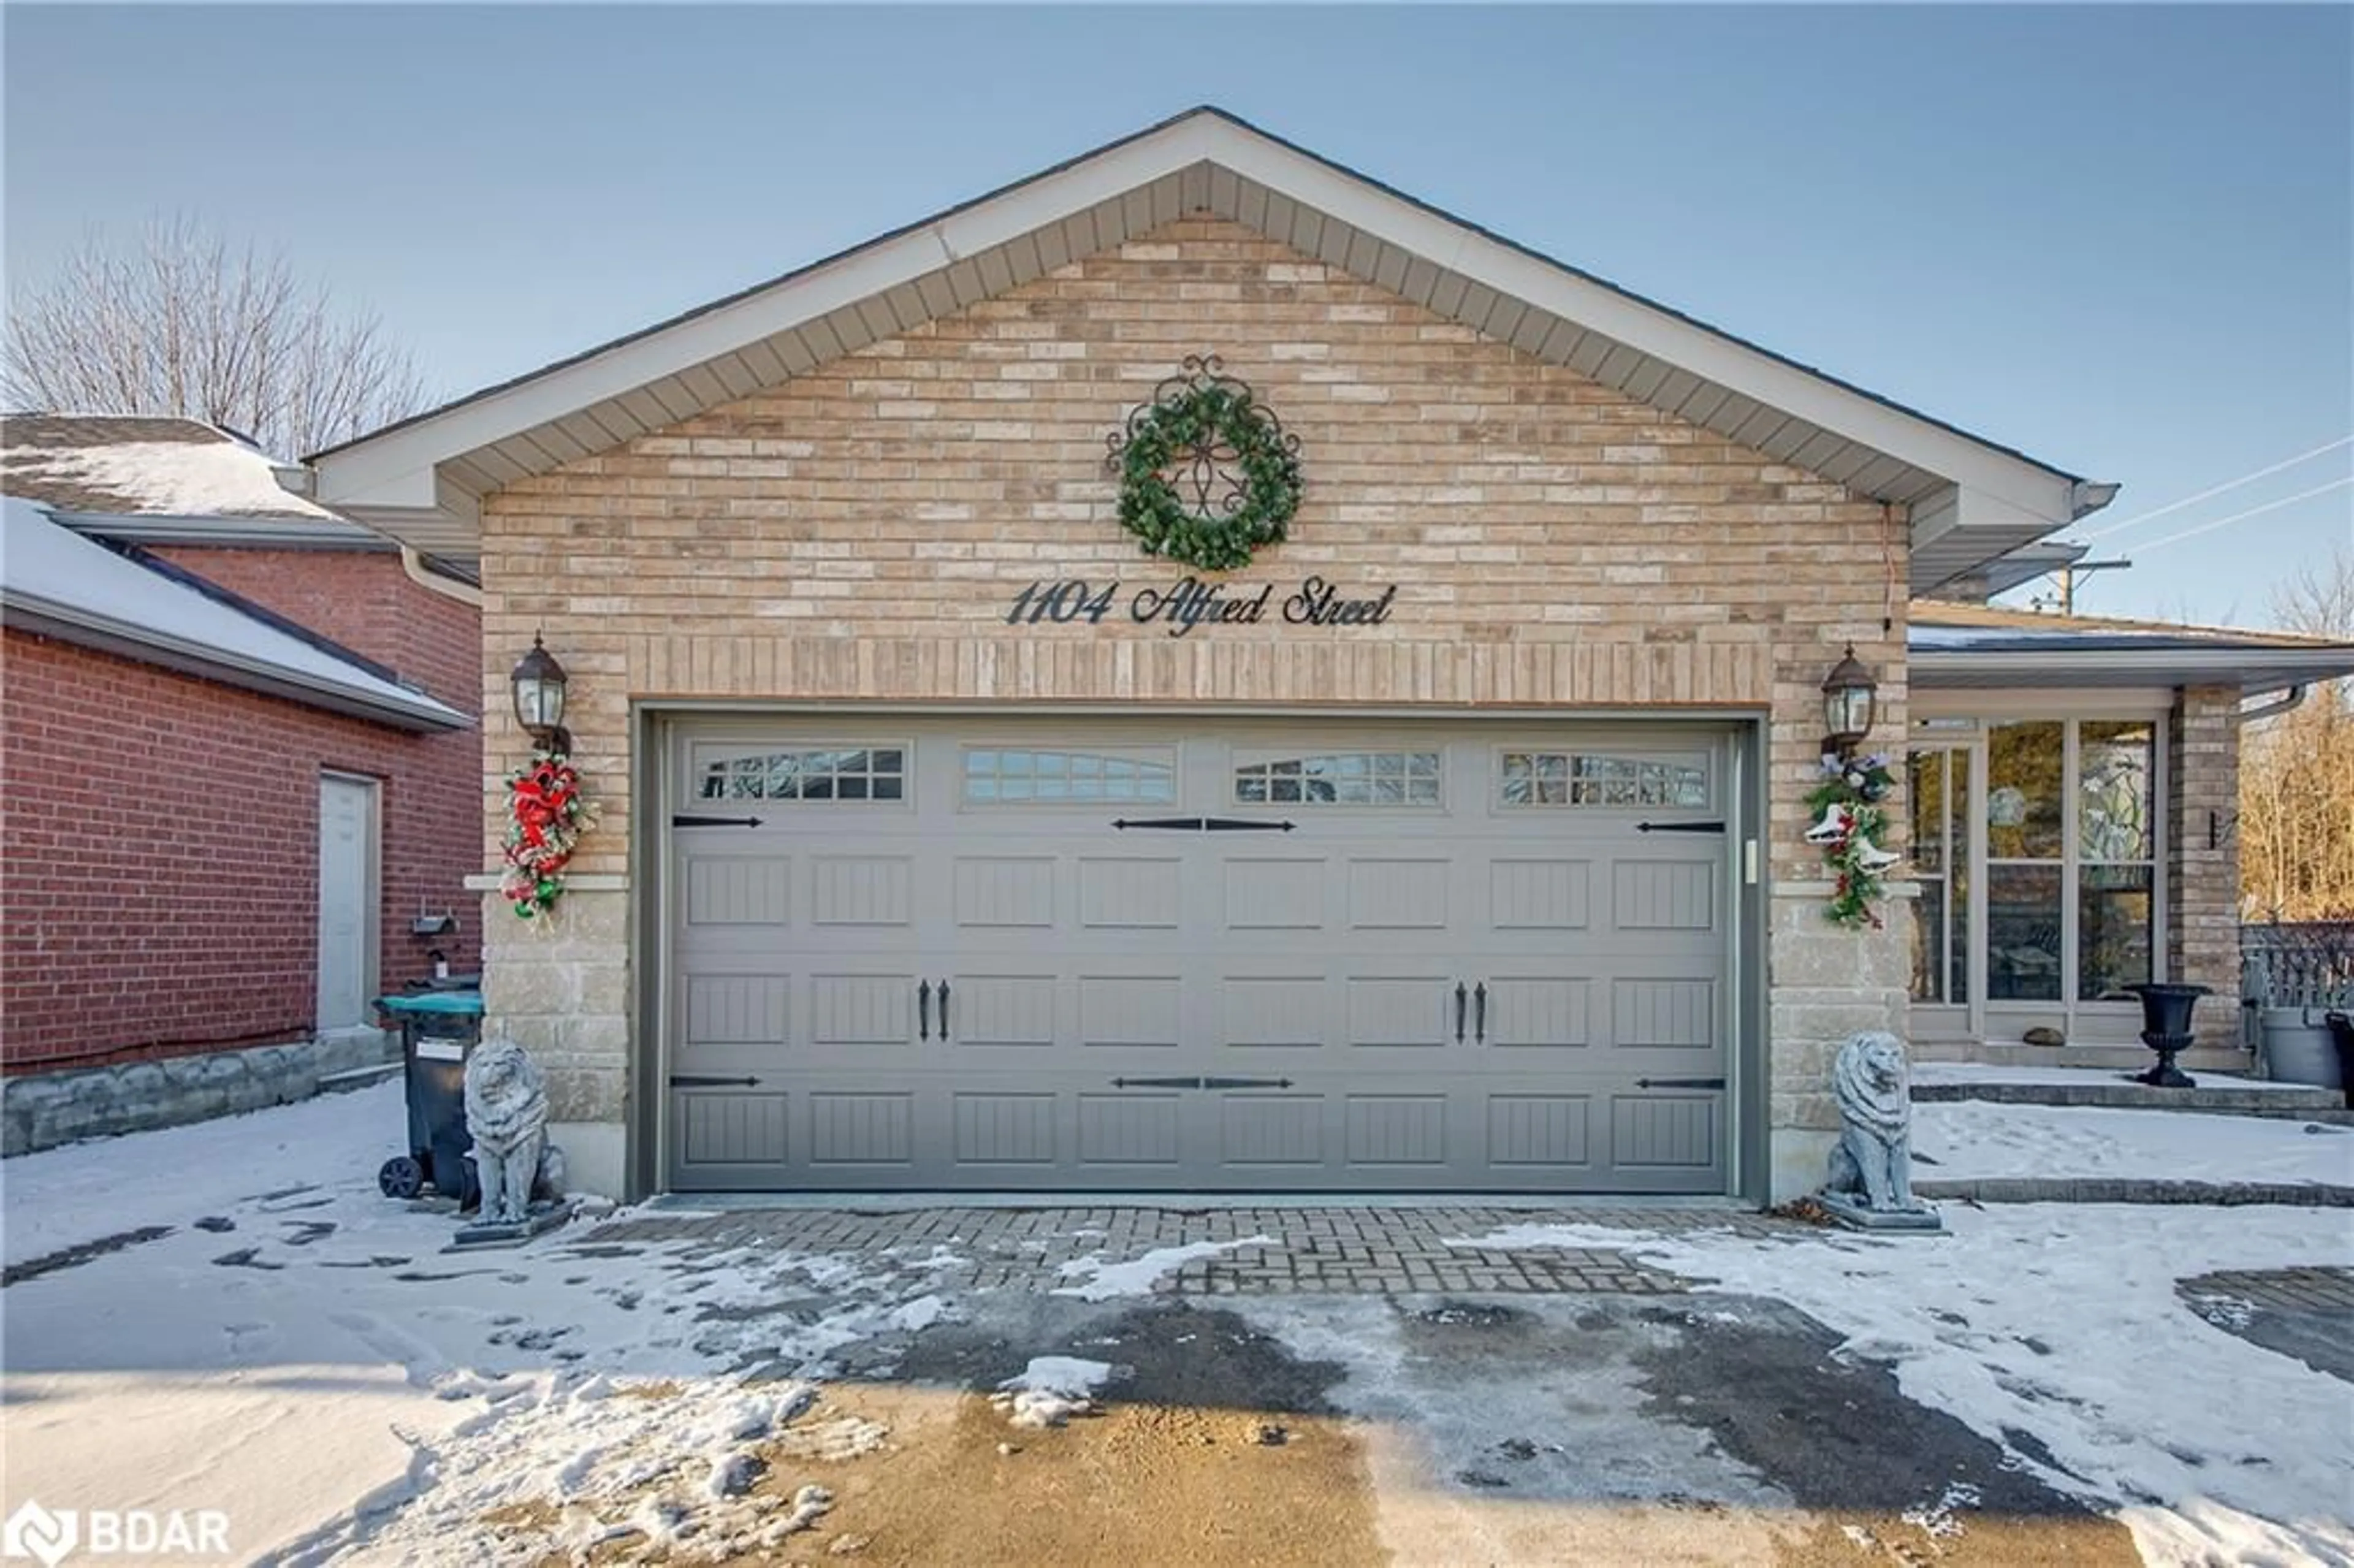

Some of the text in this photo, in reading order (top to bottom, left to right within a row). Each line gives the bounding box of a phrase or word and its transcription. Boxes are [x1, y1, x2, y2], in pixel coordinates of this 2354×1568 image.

[1003, 574, 1397, 637] 1104 Alfred Street
